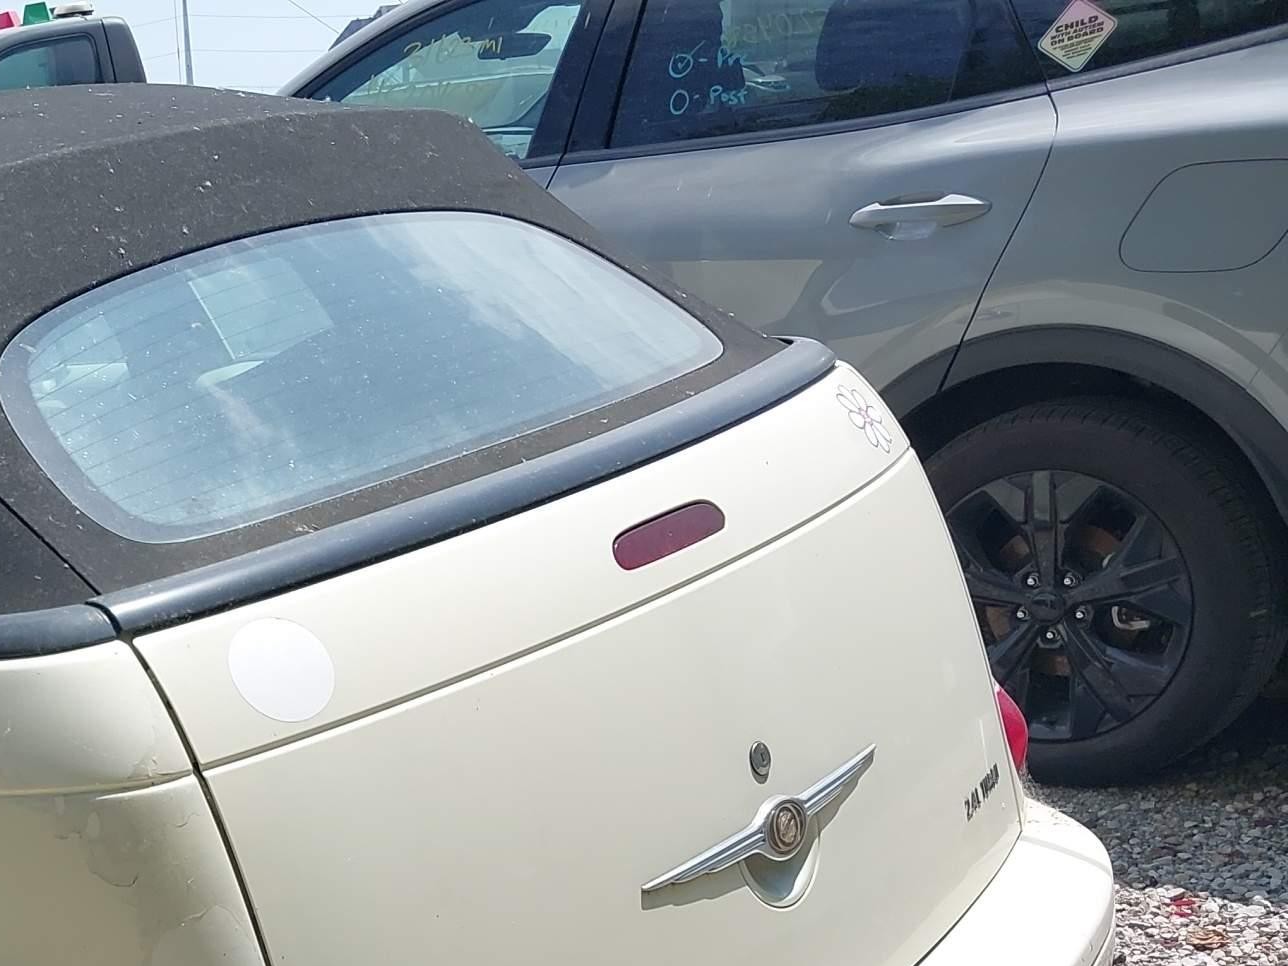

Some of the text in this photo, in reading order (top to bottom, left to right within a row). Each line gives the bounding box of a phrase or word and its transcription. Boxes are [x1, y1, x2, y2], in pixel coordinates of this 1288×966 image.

[1055, 15, 1099, 33] CHILD
[1050, 30, 1071, 40] WITH
[1050, 27, 1104, 46] ON BOARD
[709, 85, 749, 105] Post
